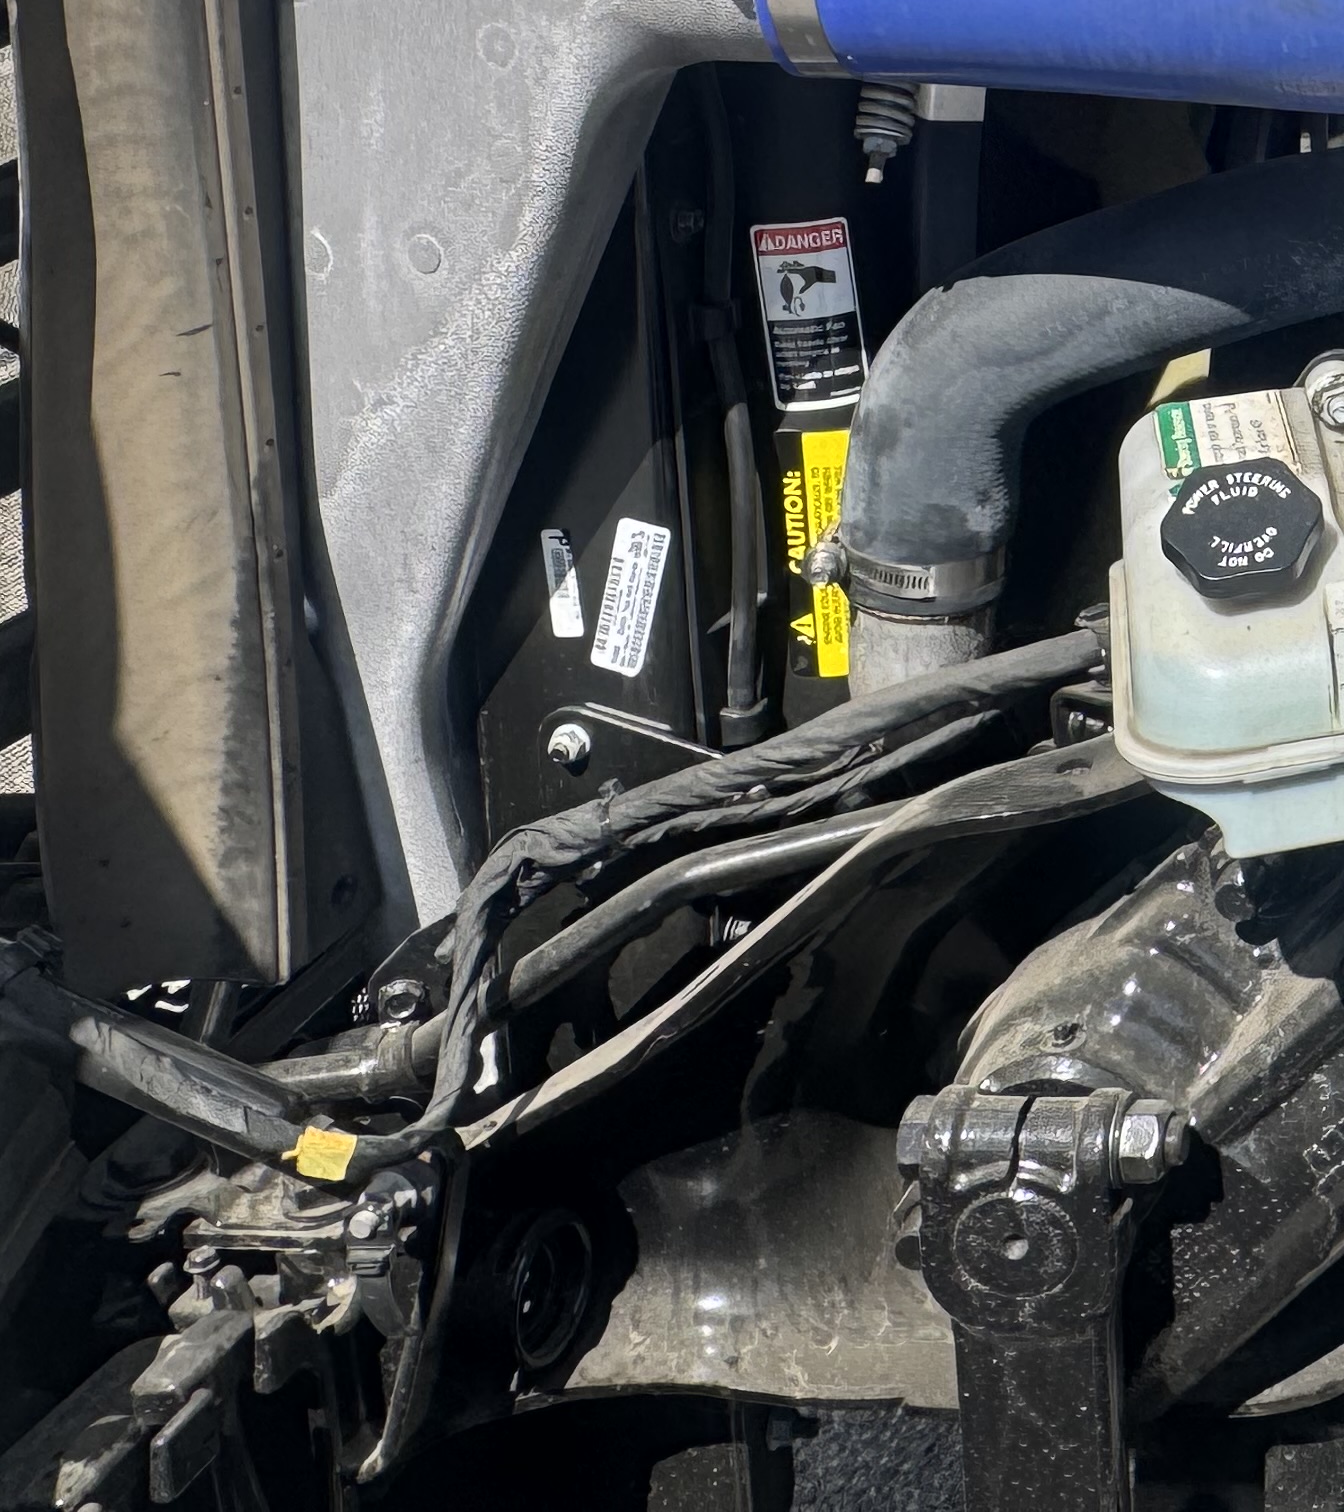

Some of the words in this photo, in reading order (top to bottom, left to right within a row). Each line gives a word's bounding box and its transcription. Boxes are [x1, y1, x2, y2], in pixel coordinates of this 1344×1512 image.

[775, 228, 844, 251] DANGER
[1182, 479, 1220, 515] POWER
[1226, 472, 1292, 499] STEERING
[1211, 485, 1259, 505] FLUID
[1209, 526, 1278, 554] OVERFILL
[1217, 555, 1249, 567] NOT
[1254, 547, 1275, 563] DO
